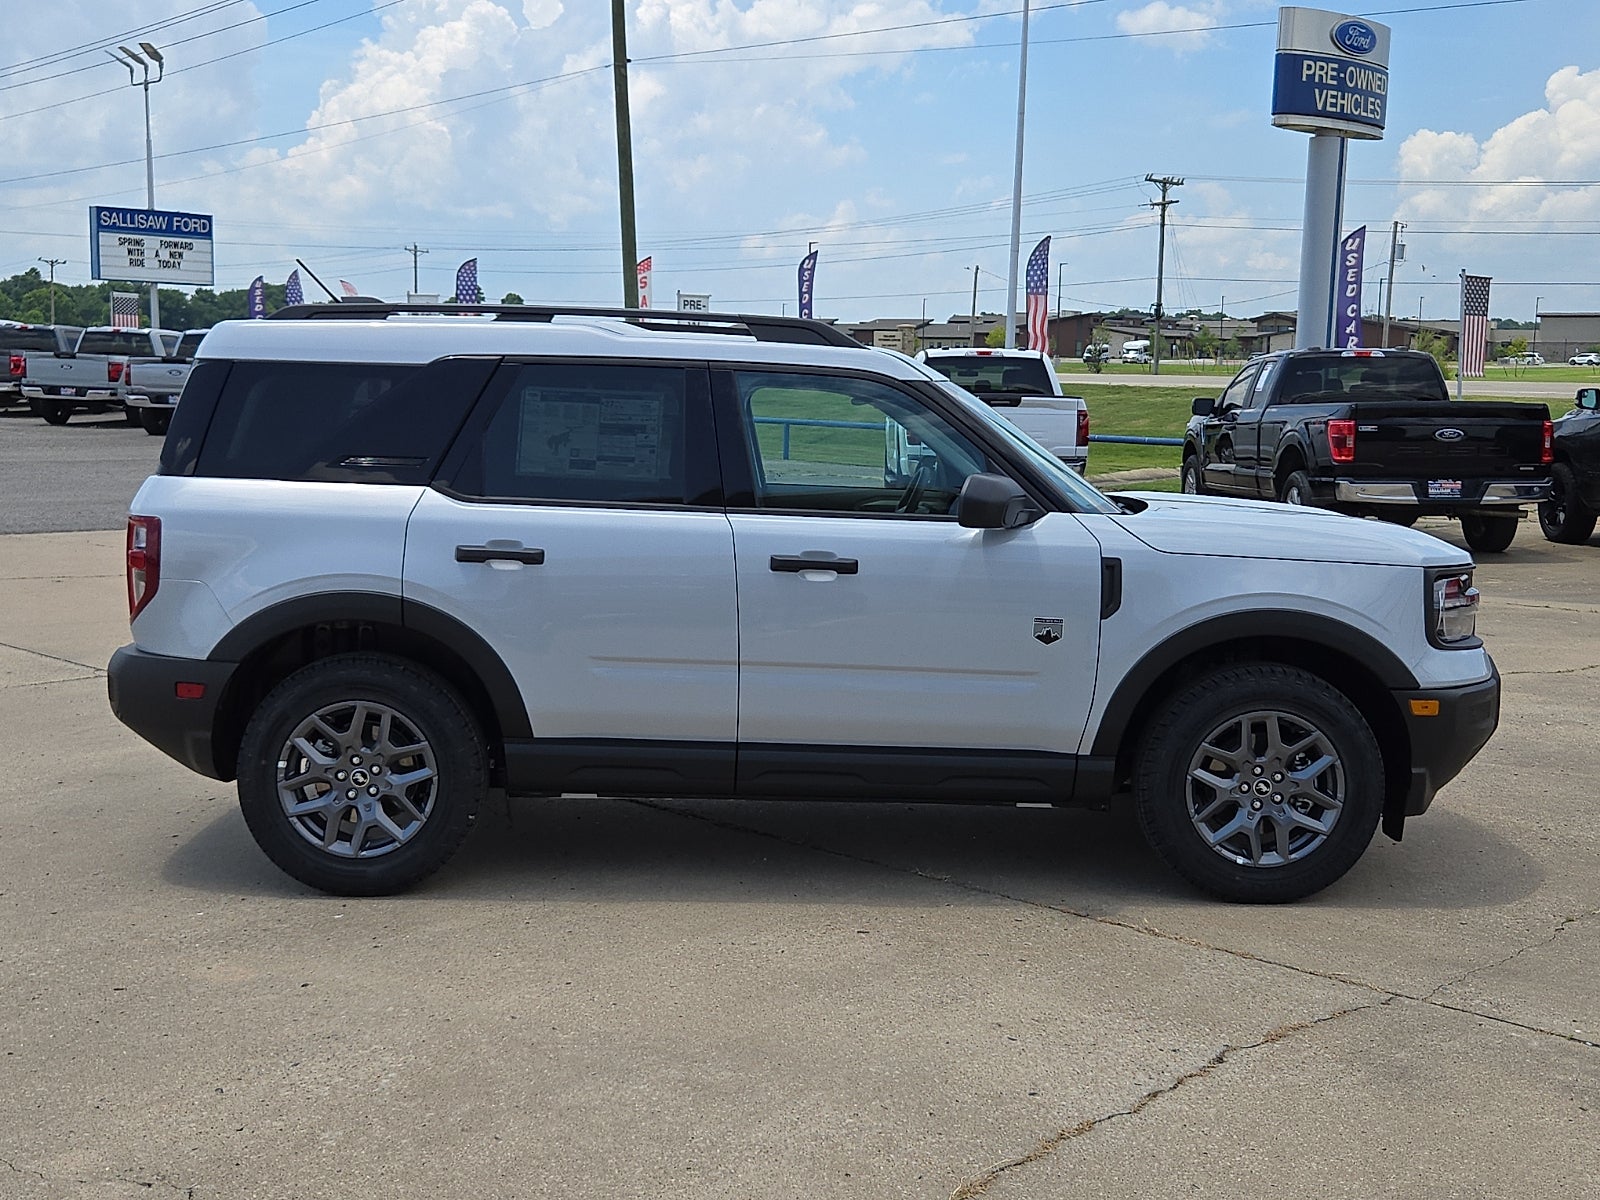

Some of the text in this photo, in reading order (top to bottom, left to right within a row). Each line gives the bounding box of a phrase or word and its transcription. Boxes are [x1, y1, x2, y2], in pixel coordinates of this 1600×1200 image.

[1345, 25, 1371, 49] Ford
[1301, 59, 1387, 95] PRE-OWNED
[1314, 88, 1382, 119] VEHICLES
[100, 211, 210, 233] SALLISAW FORD
[118, 237, 194, 251] SPRING FORWARD
[127, 248, 184, 260] WITH A NEW
[129, 258, 182, 270] RIDE TODAY
[1345, 237, 1360, 298] USED
[802, 259, 814, 304] USED
[683, 299, 707, 311] PRE-
